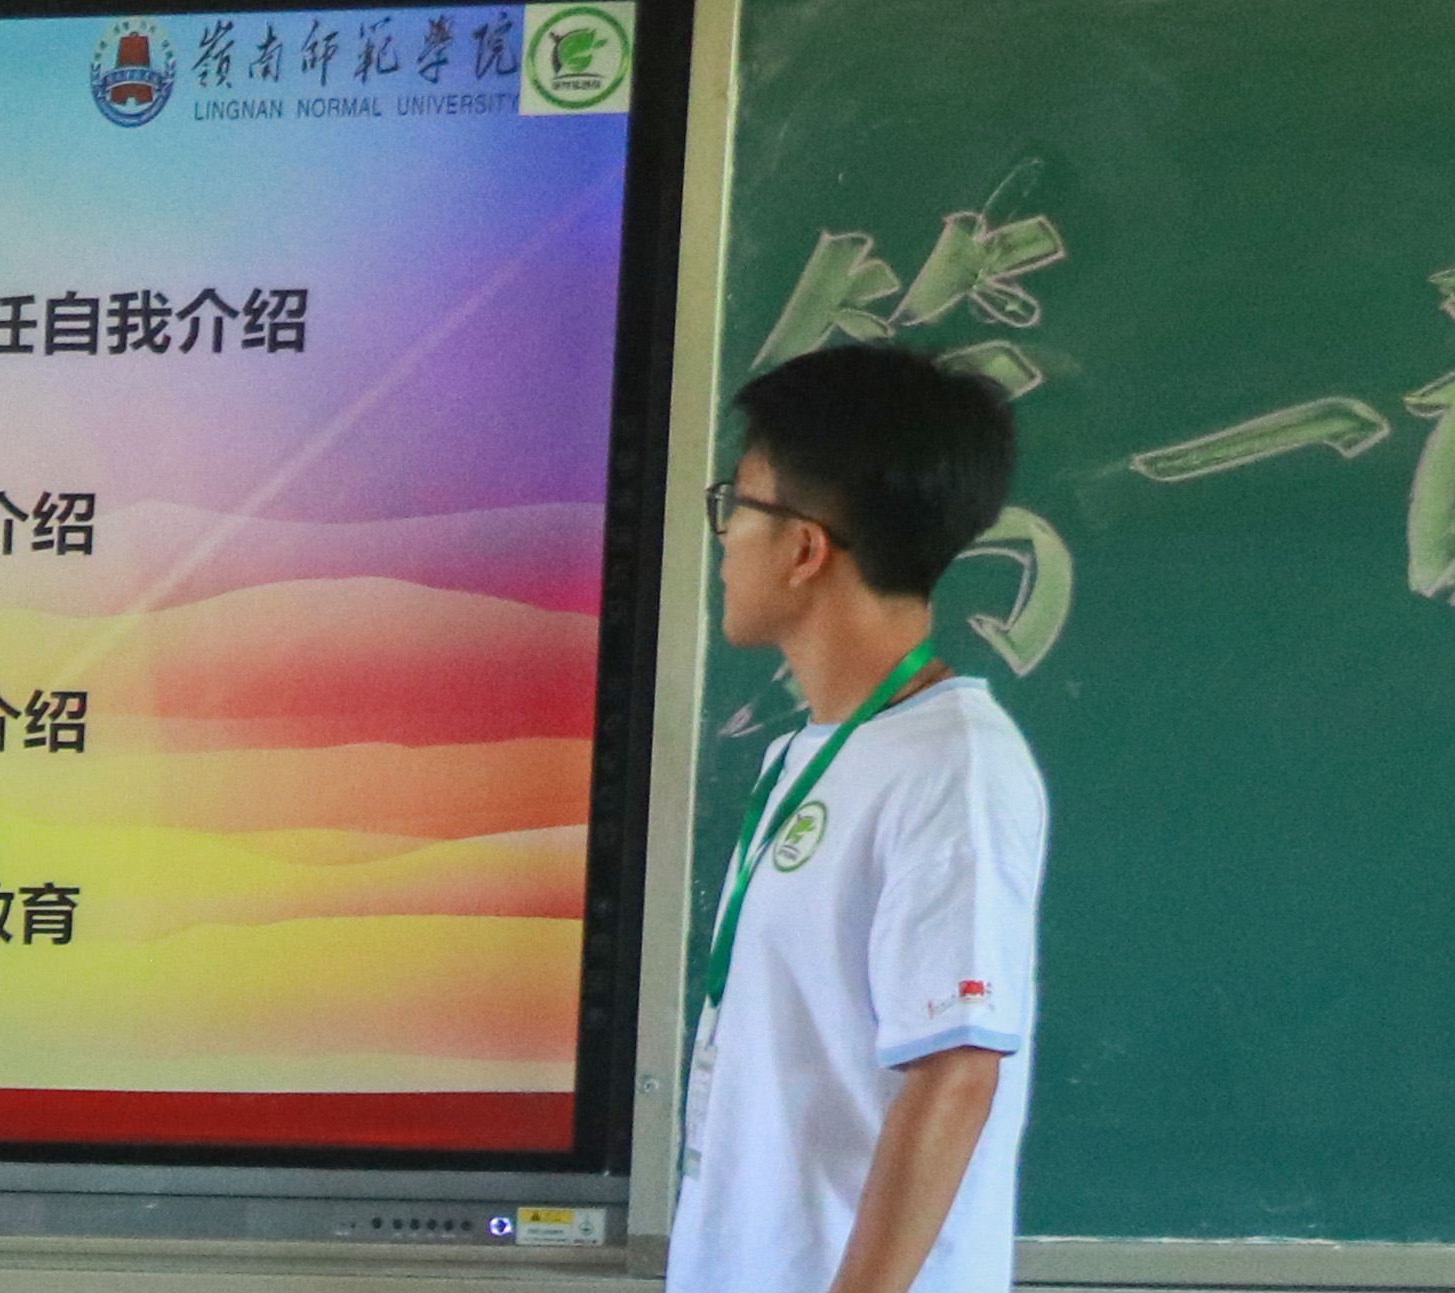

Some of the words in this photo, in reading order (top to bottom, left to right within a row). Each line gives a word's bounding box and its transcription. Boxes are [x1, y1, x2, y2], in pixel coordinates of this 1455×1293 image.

[194, 100, 283, 121] LINGNAN
[297, 97, 382, 118] NORMAL
[397, 92, 520, 117] UNIVERSITY
